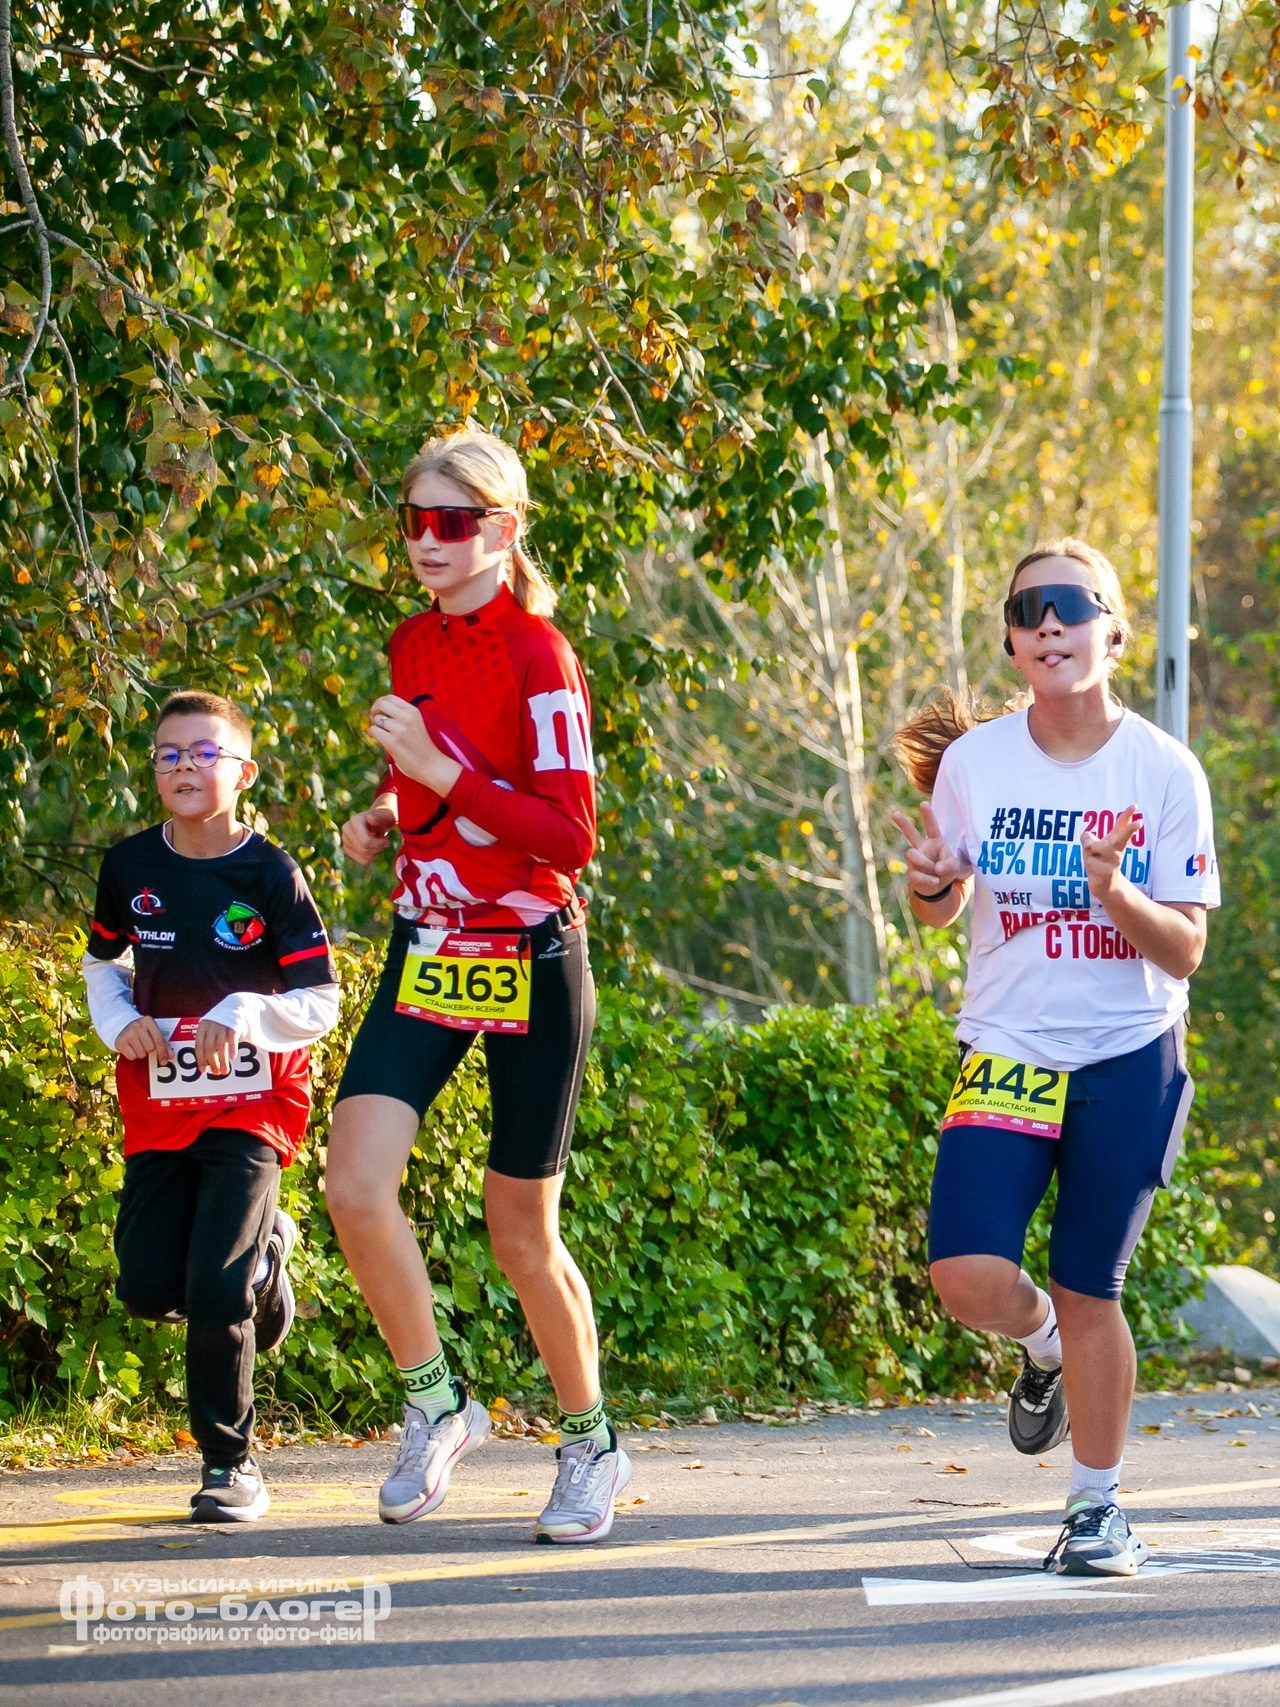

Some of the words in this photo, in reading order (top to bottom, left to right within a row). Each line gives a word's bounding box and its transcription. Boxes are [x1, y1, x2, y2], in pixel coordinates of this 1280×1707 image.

[977, 841, 1026, 876] 45%
[1032, 842, 1150, 885] ПЛАТЫ
[538, 949, 570, 960] DEMIX
[1045, 924, 1062, 960] С
[413, 961, 519, 1004] 5163
[425, 998, 475, 1012] СТАШКЕВИЧ
[475, 1002, 506, 1014] ЯСЕНИЯ
[986, 1099, 1037, 1114] АНАСТАСИЯ
